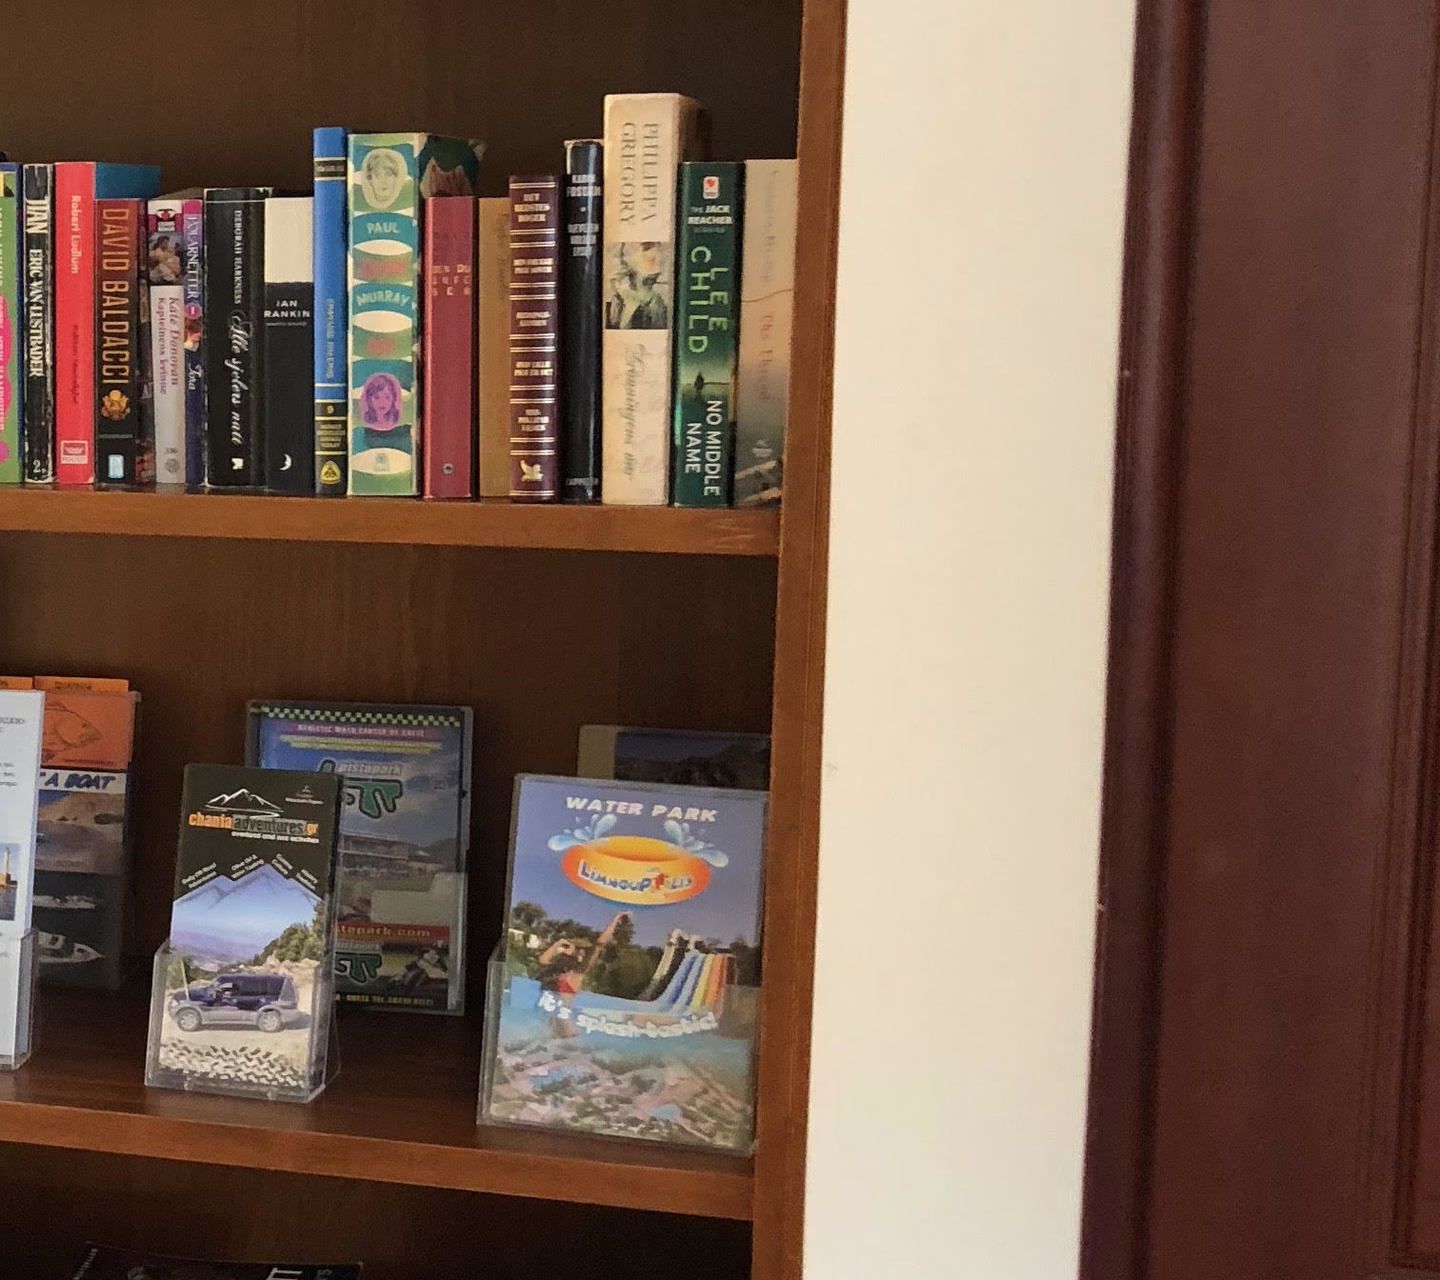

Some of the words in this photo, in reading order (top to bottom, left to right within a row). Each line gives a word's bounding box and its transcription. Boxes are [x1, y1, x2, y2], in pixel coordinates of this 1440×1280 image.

[618, 122, 635, 226] GREGORY
[640, 122, 659, 221] PHILIPPA
[26, 197, 50, 234] JIAN
[70, 195, 82, 231] Robert
[366, 222, 400, 234] PAUL
[70, 235, 82, 274] Ludlum
[101, 208, 130, 271] DAVID
[186, 215, 200, 299] POLARNETTER
[29, 249, 43, 277] ERIC
[29, 279, 44, 302] VAN
[688, 246, 710, 353] CHILD
[708, 267, 728, 332] LEE
[101, 280, 130, 384] BALDACCI
[263, 310, 311, 318] RANKIN
[29, 305, 45, 377] LUSTBADER
[705, 400, 722, 425] NO
[684, 422, 701, 474] NAME
[703, 430, 721, 496] MIDDLE
[45, 774, 59, 786] A
[64, 774, 115, 789] BOAT
[566, 796, 644, 816] WATER
[651, 804, 718, 823] PARK
